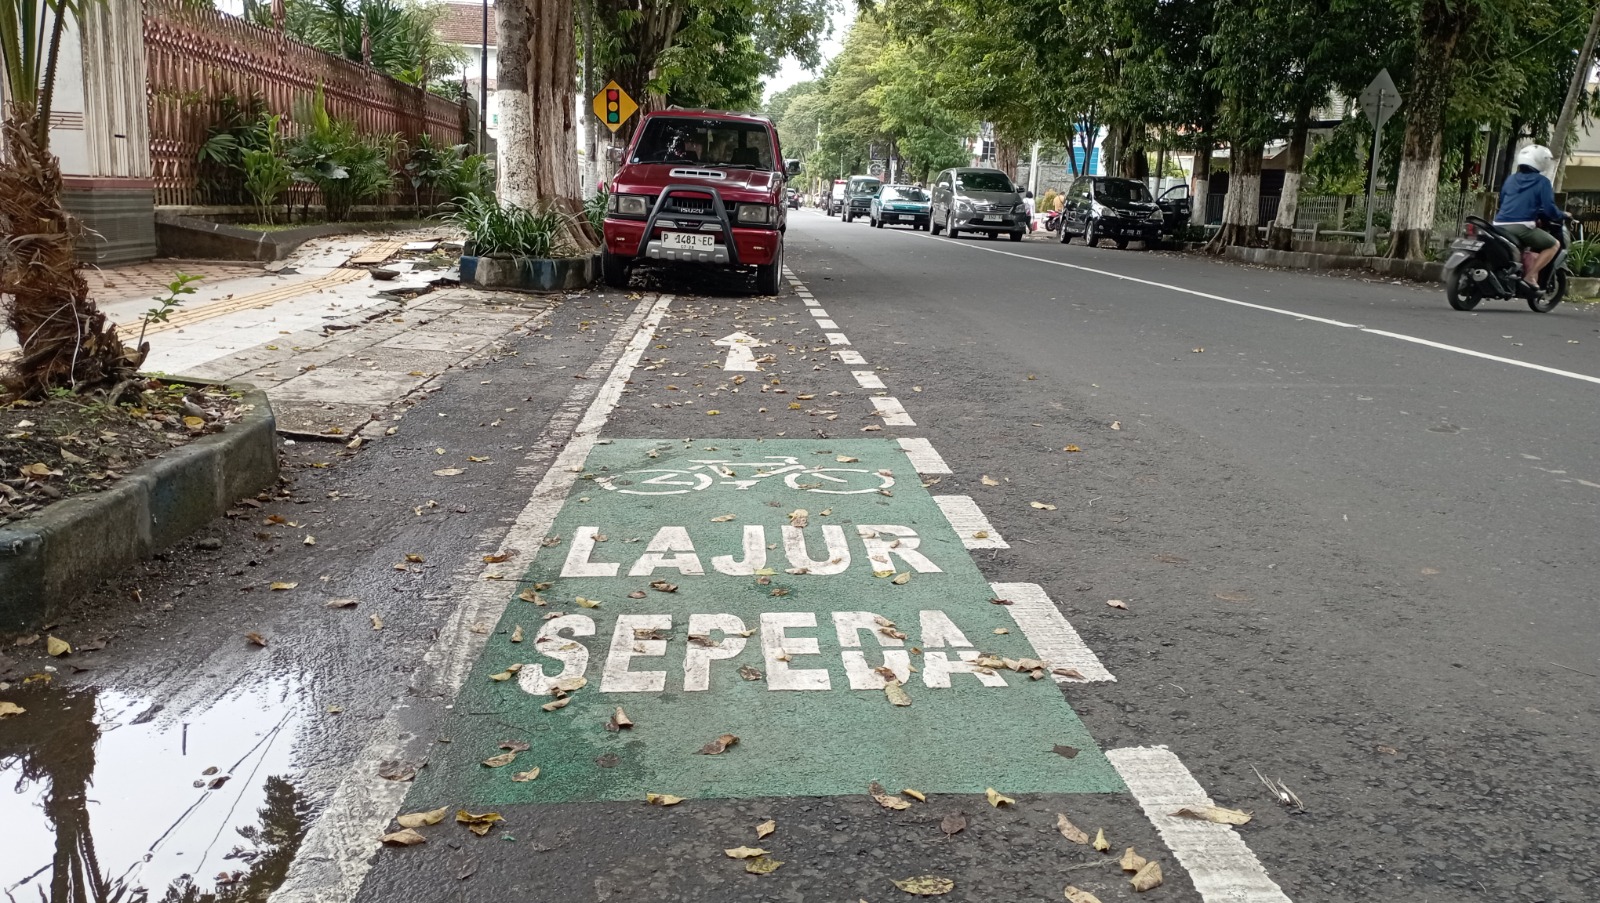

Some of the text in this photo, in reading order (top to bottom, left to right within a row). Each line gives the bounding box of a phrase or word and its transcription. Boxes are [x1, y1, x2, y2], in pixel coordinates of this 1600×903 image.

[663, 233, 713, 246] P 1481 EC
[559, 524, 944, 578] LAJUR
[517, 609, 1009, 696] SEPEDA
